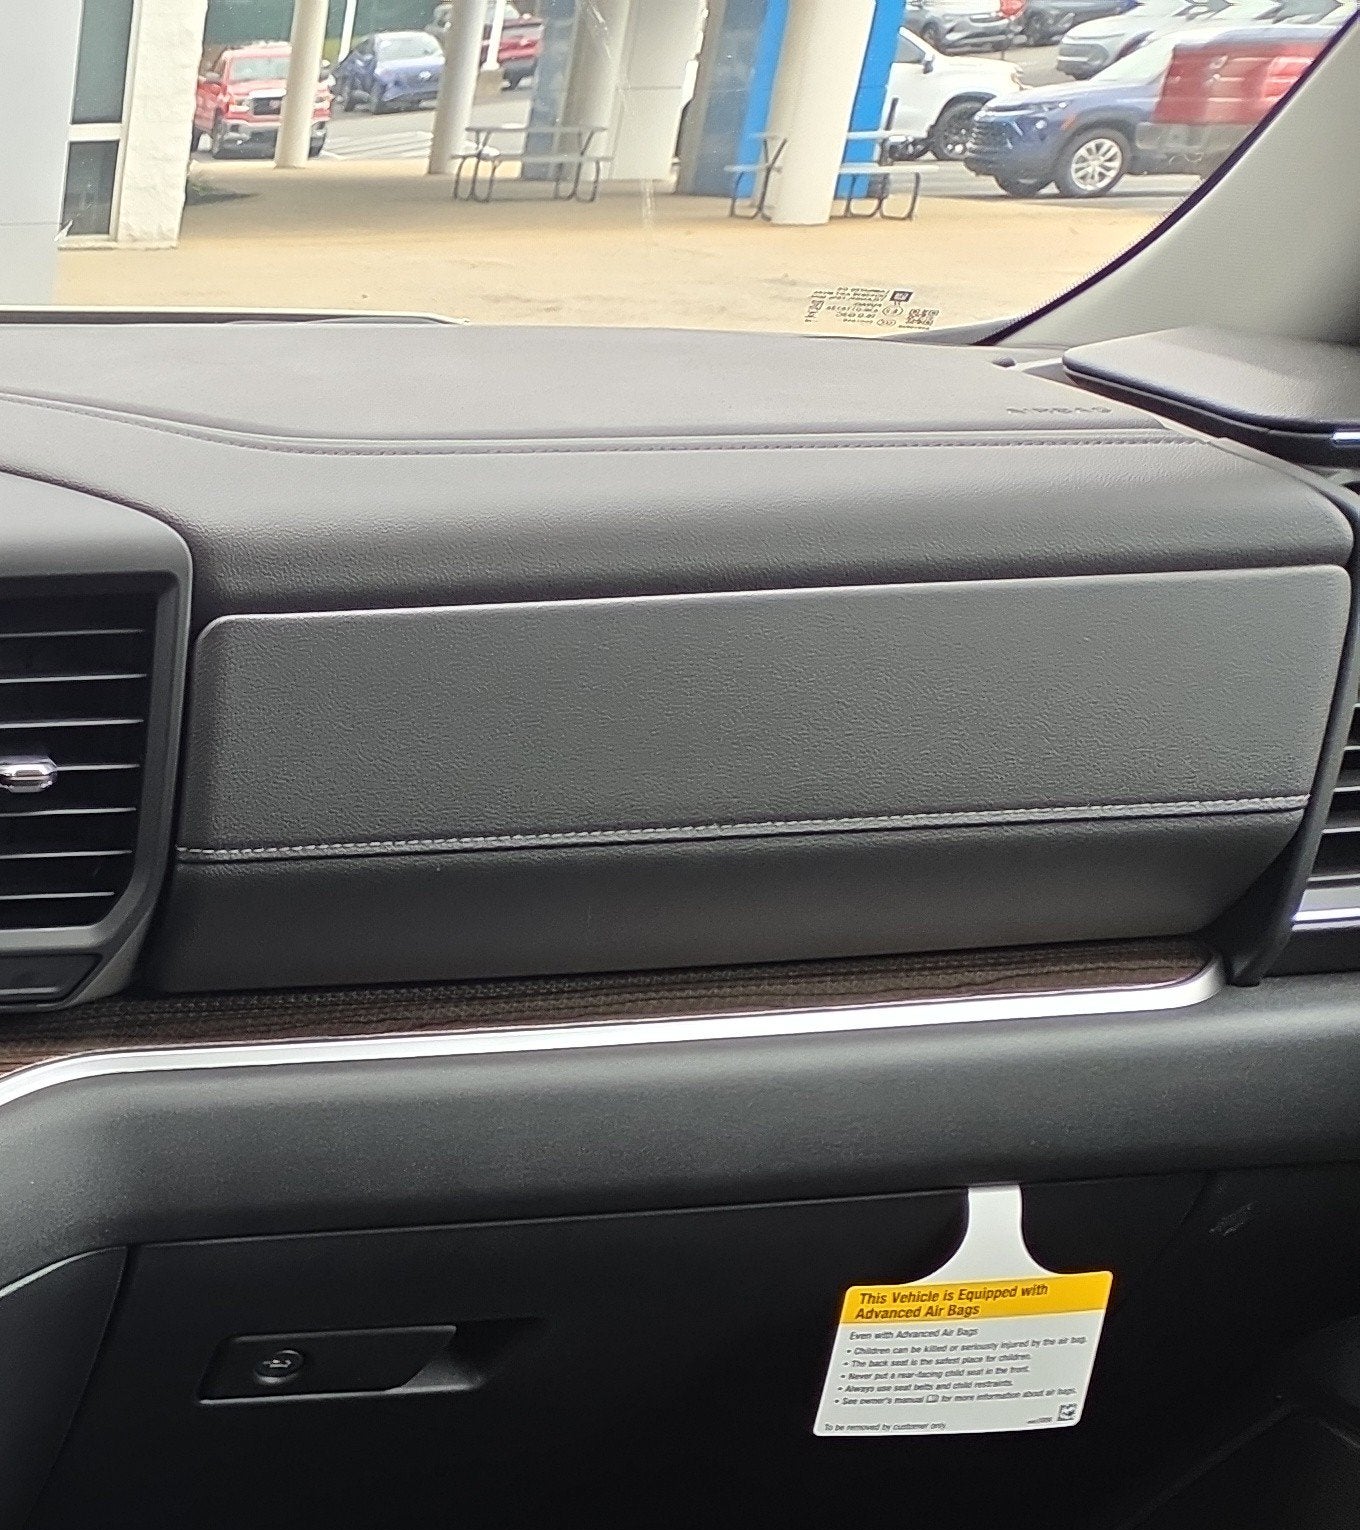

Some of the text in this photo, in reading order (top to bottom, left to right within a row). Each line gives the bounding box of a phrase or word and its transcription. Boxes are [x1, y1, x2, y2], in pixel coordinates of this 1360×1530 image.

[859, 1283, 1049, 1305] This Vehicle is Equipped with
[855, 1304, 980, 1320] Advanced Air Bags
